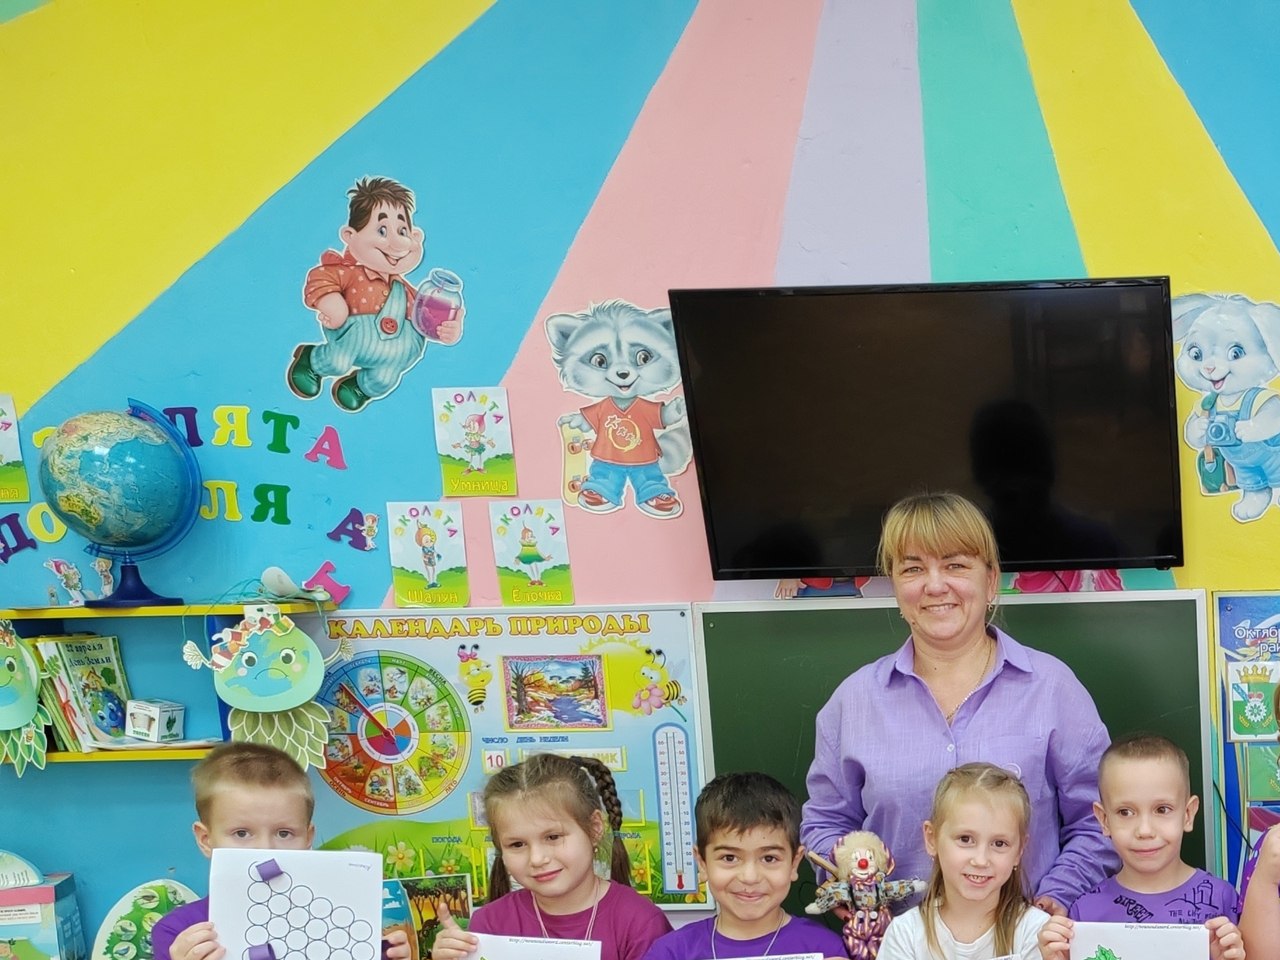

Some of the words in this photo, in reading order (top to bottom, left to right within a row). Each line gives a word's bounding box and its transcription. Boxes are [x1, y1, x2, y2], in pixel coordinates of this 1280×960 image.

[439, 392, 503, 425] ЭКОЛЯТА
[450, 478, 508, 493] Умница
[394, 506, 458, 538] ЭКОЛЯТА
[496, 504, 560, 537] ЭКОЛЯТА
[408, 589, 458, 604] Шалун
[512, 586, 562, 602] Ёлочка
[328, 617, 503, 639] КАЛЕНДАРЬ
[508, 614, 650, 637] ПРИРОДЫ
[487, 755, 504, 768] 10
